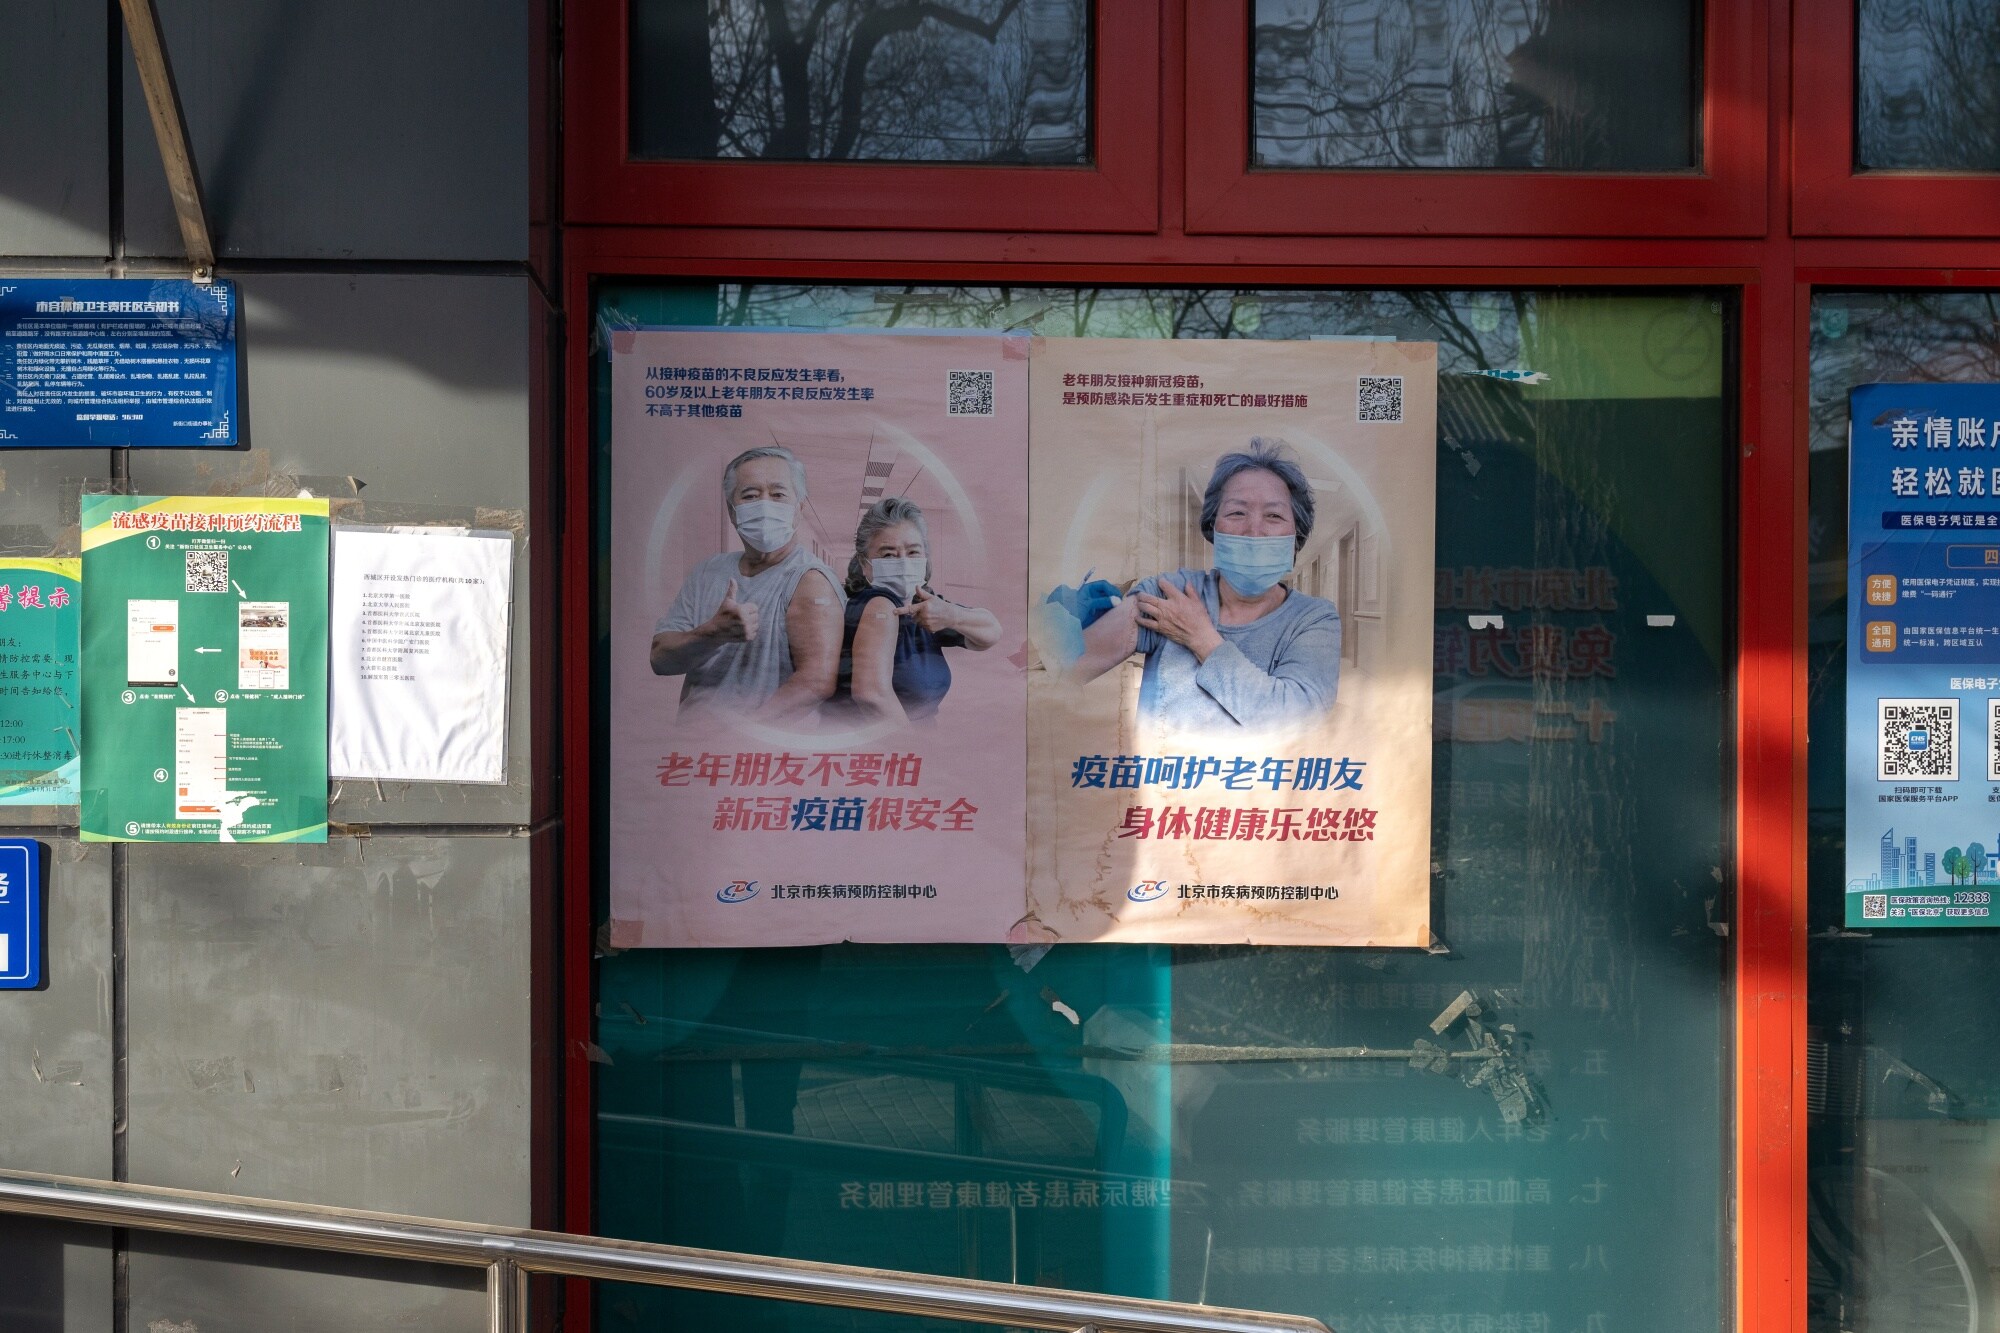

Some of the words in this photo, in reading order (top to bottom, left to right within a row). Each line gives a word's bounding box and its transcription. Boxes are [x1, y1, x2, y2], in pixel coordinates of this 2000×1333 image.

[645, 385, 874, 401] 60岁及以上老年朋友不良反应发生率
[1062, 392, 1308, 408] 是预防感染后发生重症和死亡的最好措施
[645, 404, 742, 418] 不高于其他疫苗
[111, 512, 302, 532] 流感疫苗接种预约流程
[1901, 514, 1998, 526] 医保电子凭证是全
[1872, 579, 1891, 588] 方便
[1872, 592, 1891, 601] 快捷
[1872, 625, 1891, 636] 全国
[1872, 638, 1891, 648] 通用
[1950, 677, 2000, 690] 医保电子
[656, 752, 923, 787] 老年朋友不要怕
[1071, 755, 1367, 791] 疫苗呵护老年朋友
[1894, 786, 1943, 794] 扫码即可下载
[1878, 795, 1959, 803] 国家医保服务平台APP
[712, 797, 979, 832] 新冠疫苗很安全
[1118, 805, 1379, 842] 身体健康乐悠悠
[771, 884, 938, 900] 北京市疾病预防控制中心
[1177, 884, 1339, 900] 北京市疾病预防控制中心
[1954, 892, 1990, 904] 12333
